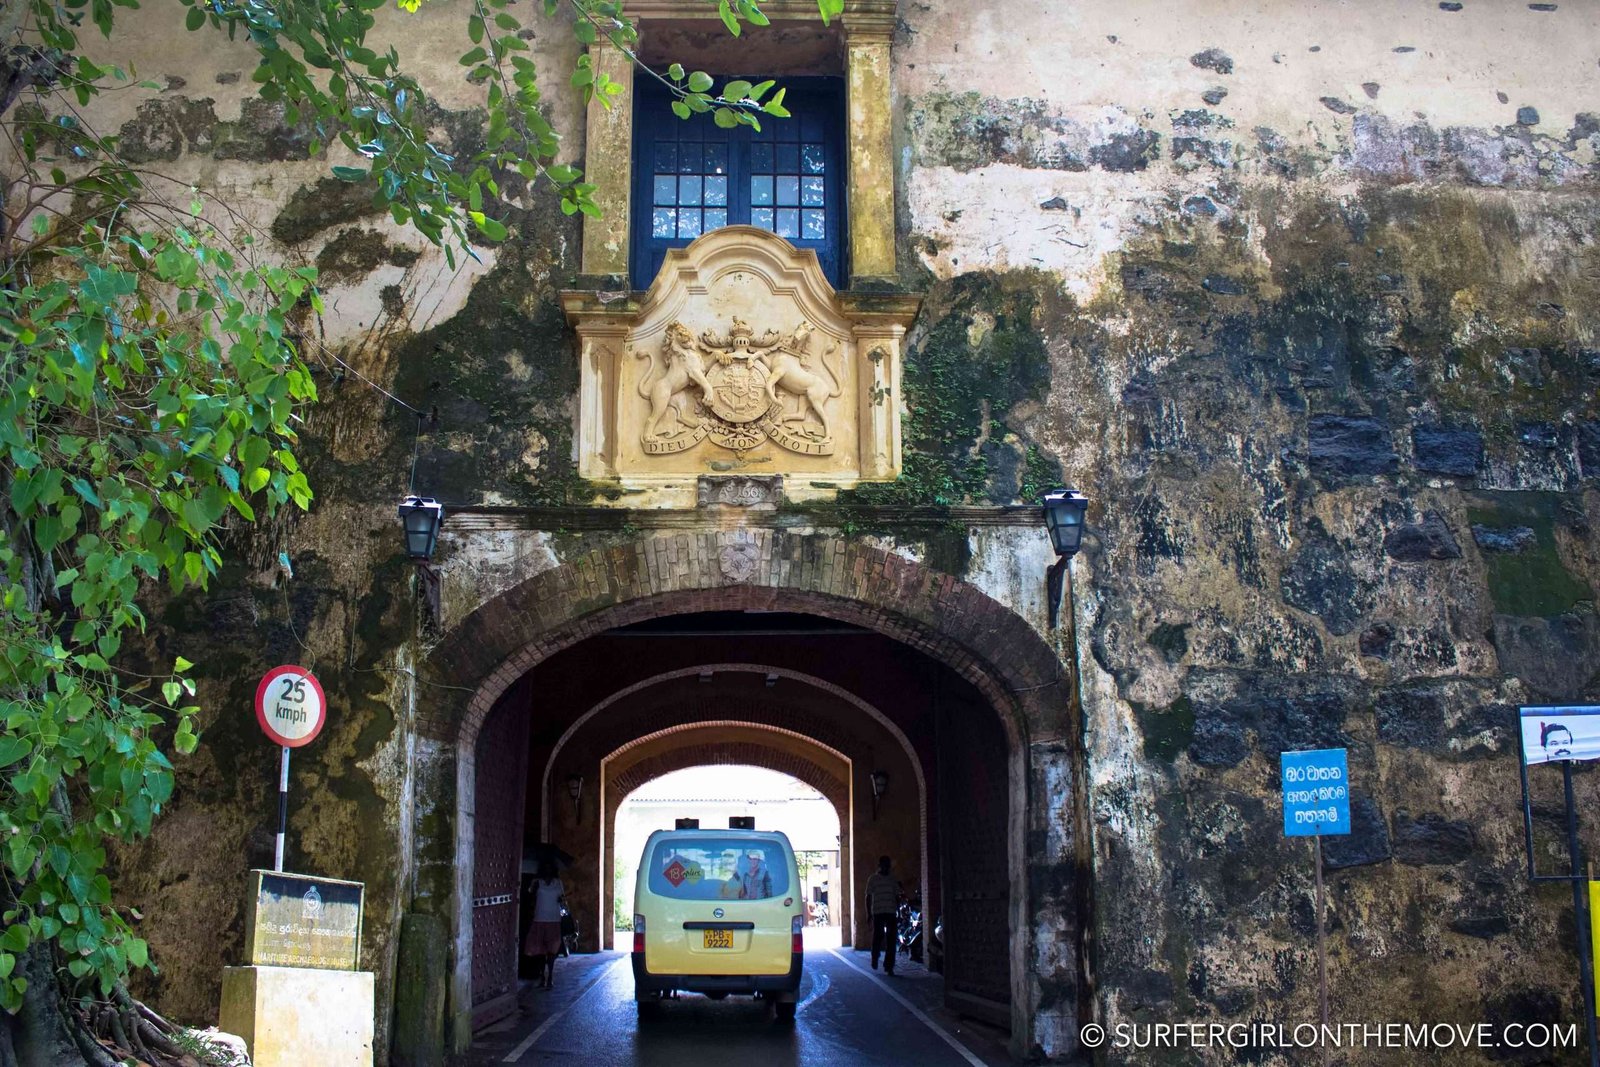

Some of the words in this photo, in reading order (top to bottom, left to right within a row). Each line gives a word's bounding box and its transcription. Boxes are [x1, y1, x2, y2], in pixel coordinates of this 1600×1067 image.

[649, 440, 686, 452] DIEU
[692, 424, 709, 442] ET
[725, 436, 759, 449] MON
[770, 428, 827, 454] DROIT
[281, 679, 305, 703] 25
[276, 702, 307, 724] kmph
[707, 939, 729, 948] 9222
